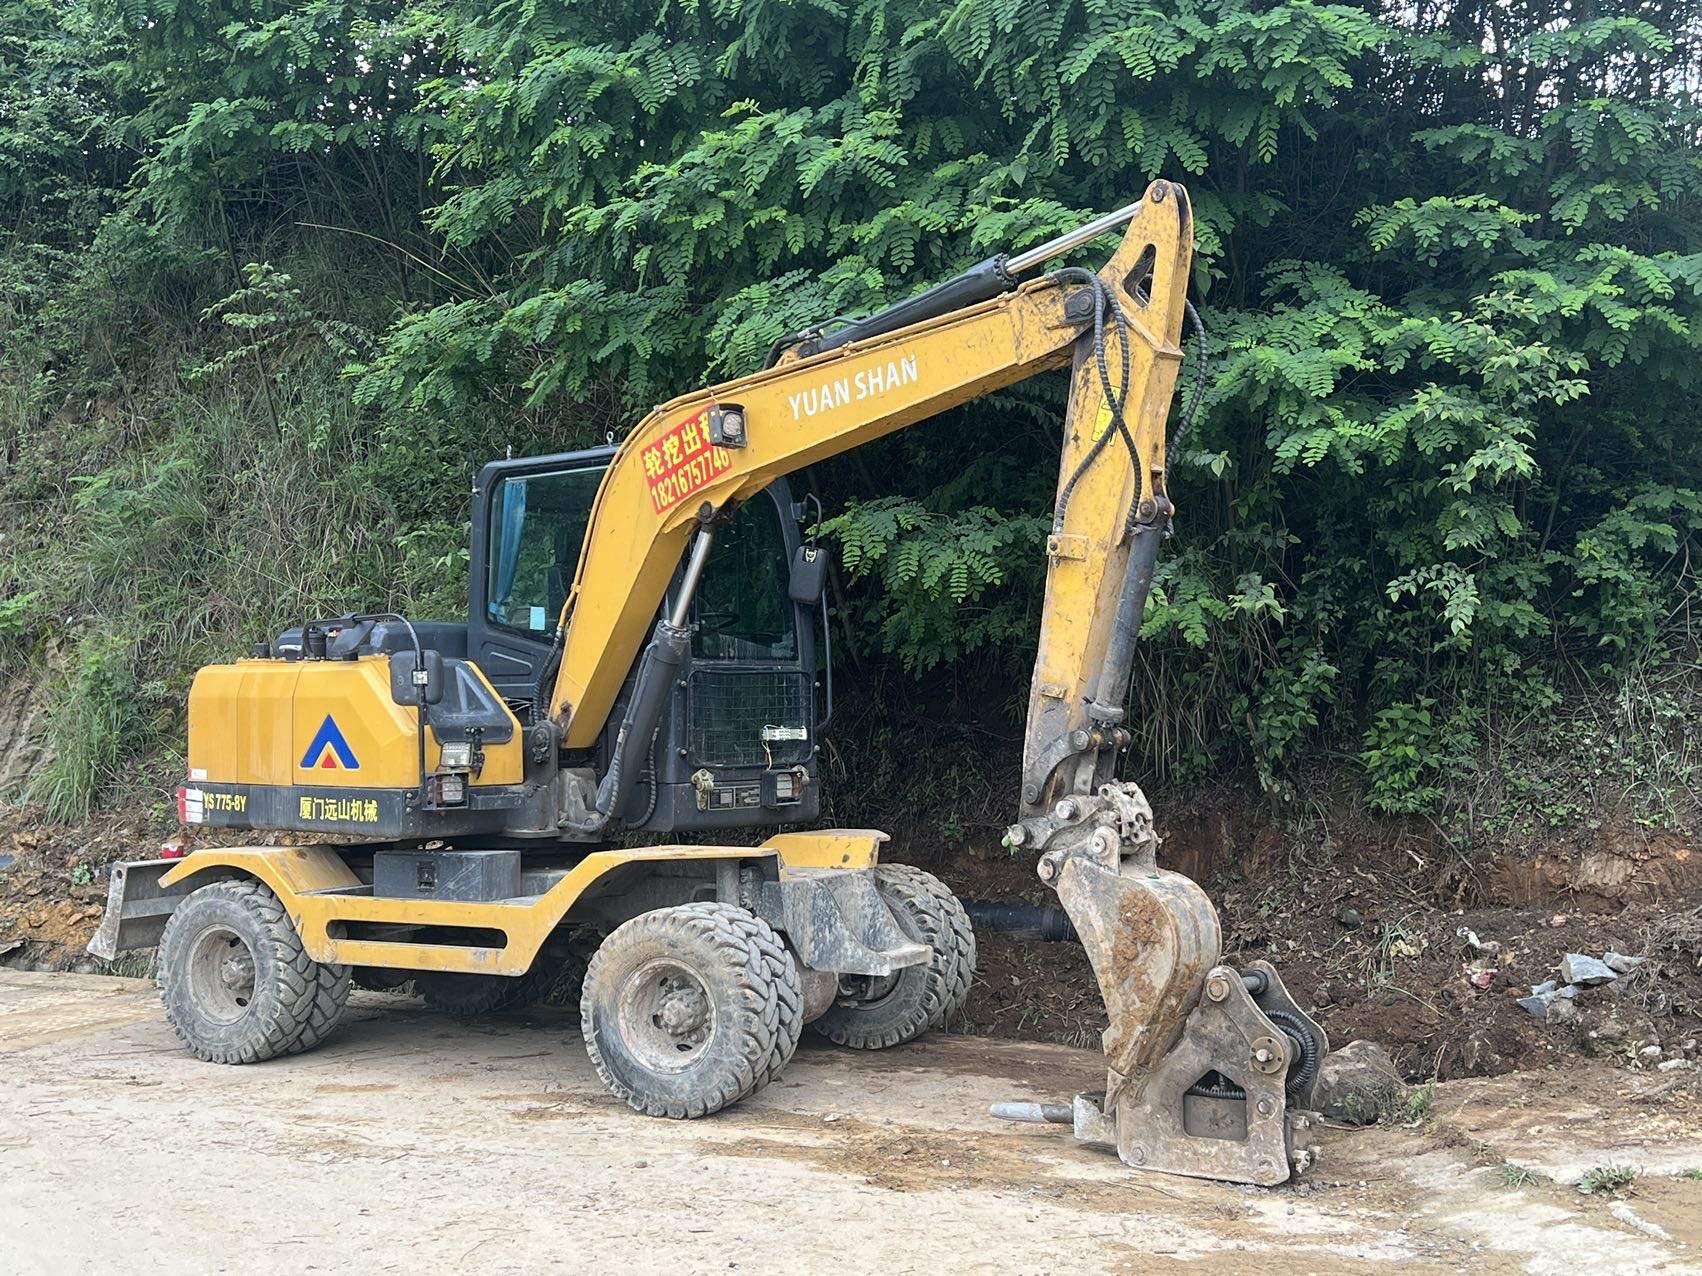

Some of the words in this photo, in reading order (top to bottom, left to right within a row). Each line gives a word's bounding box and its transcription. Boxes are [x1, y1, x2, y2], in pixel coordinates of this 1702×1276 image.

[788, 377, 850, 420] YUAN
[854, 355, 918, 400] SHAN
[651, 446, 729, 510] 18216757746
[299, 796, 378, 822] 厦门远山机械
